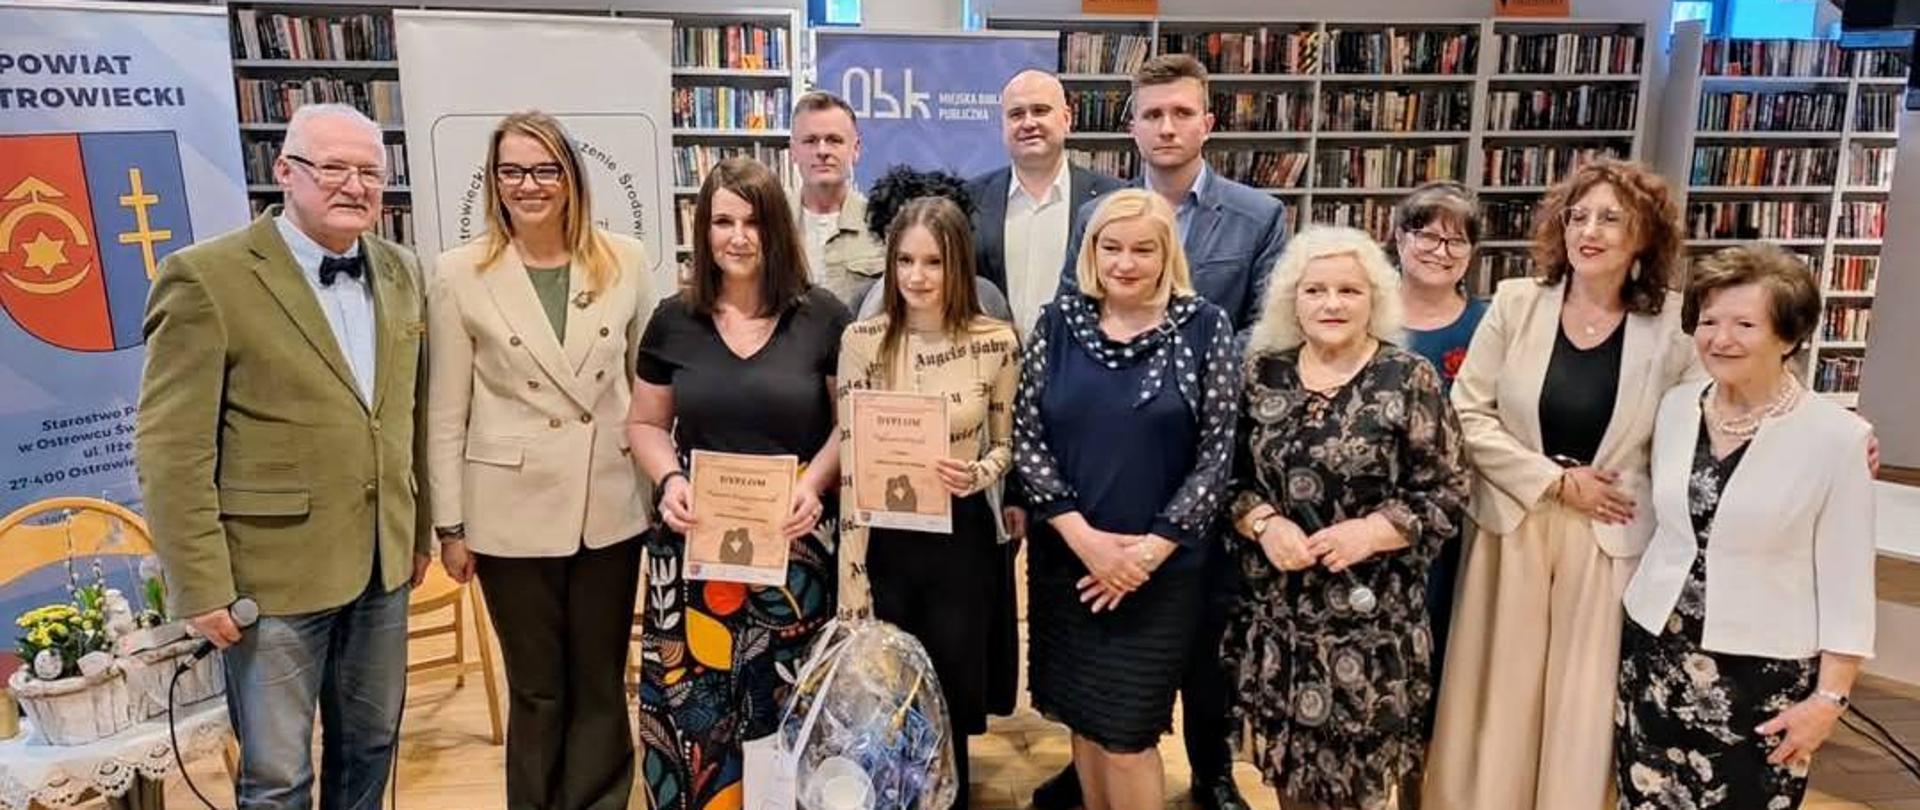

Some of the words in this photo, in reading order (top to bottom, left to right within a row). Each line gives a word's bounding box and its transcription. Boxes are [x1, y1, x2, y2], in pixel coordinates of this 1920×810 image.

[0, 53, 131, 74] POWIAT
[0, 87, 186, 109] TROWIECKI
[42, 411, 122, 432] Starostwo
[36, 428, 111, 450] Ostrowcu
[9, 470, 66, 491] 27-400
